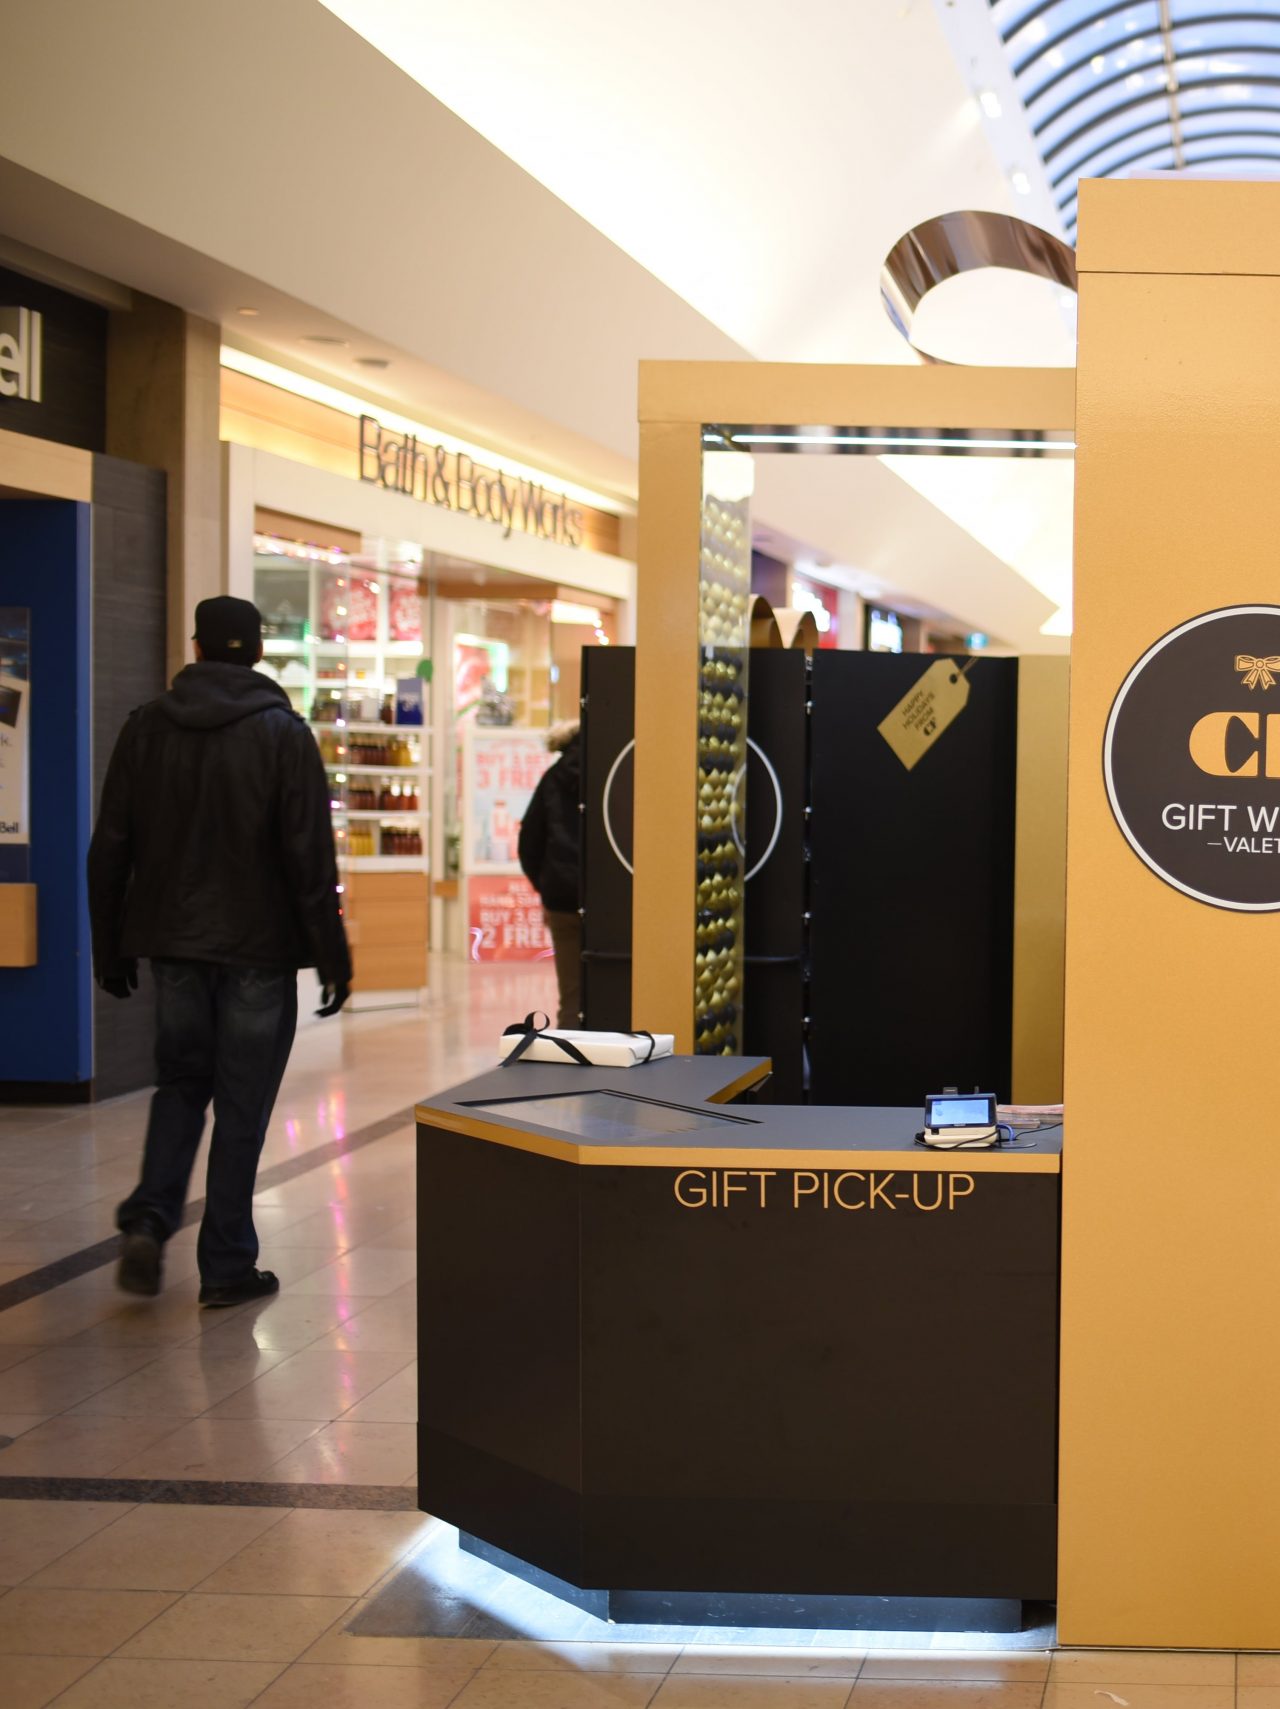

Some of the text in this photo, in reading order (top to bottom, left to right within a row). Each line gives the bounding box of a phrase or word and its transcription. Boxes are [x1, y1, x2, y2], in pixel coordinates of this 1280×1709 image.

[359, 414, 584, 548] Bath & Body Works
[902, 690, 923, 717] HAPPY
[902, 692, 935, 730] HOLIDAYS
[914, 706, 934, 731] FROM
[1161, 803, 1238, 832] GIFT
[480, 909, 511, 925] BUY
[482, 927, 496, 949] 2
[674, 1170, 975, 1211] GIFT PICK-UP
